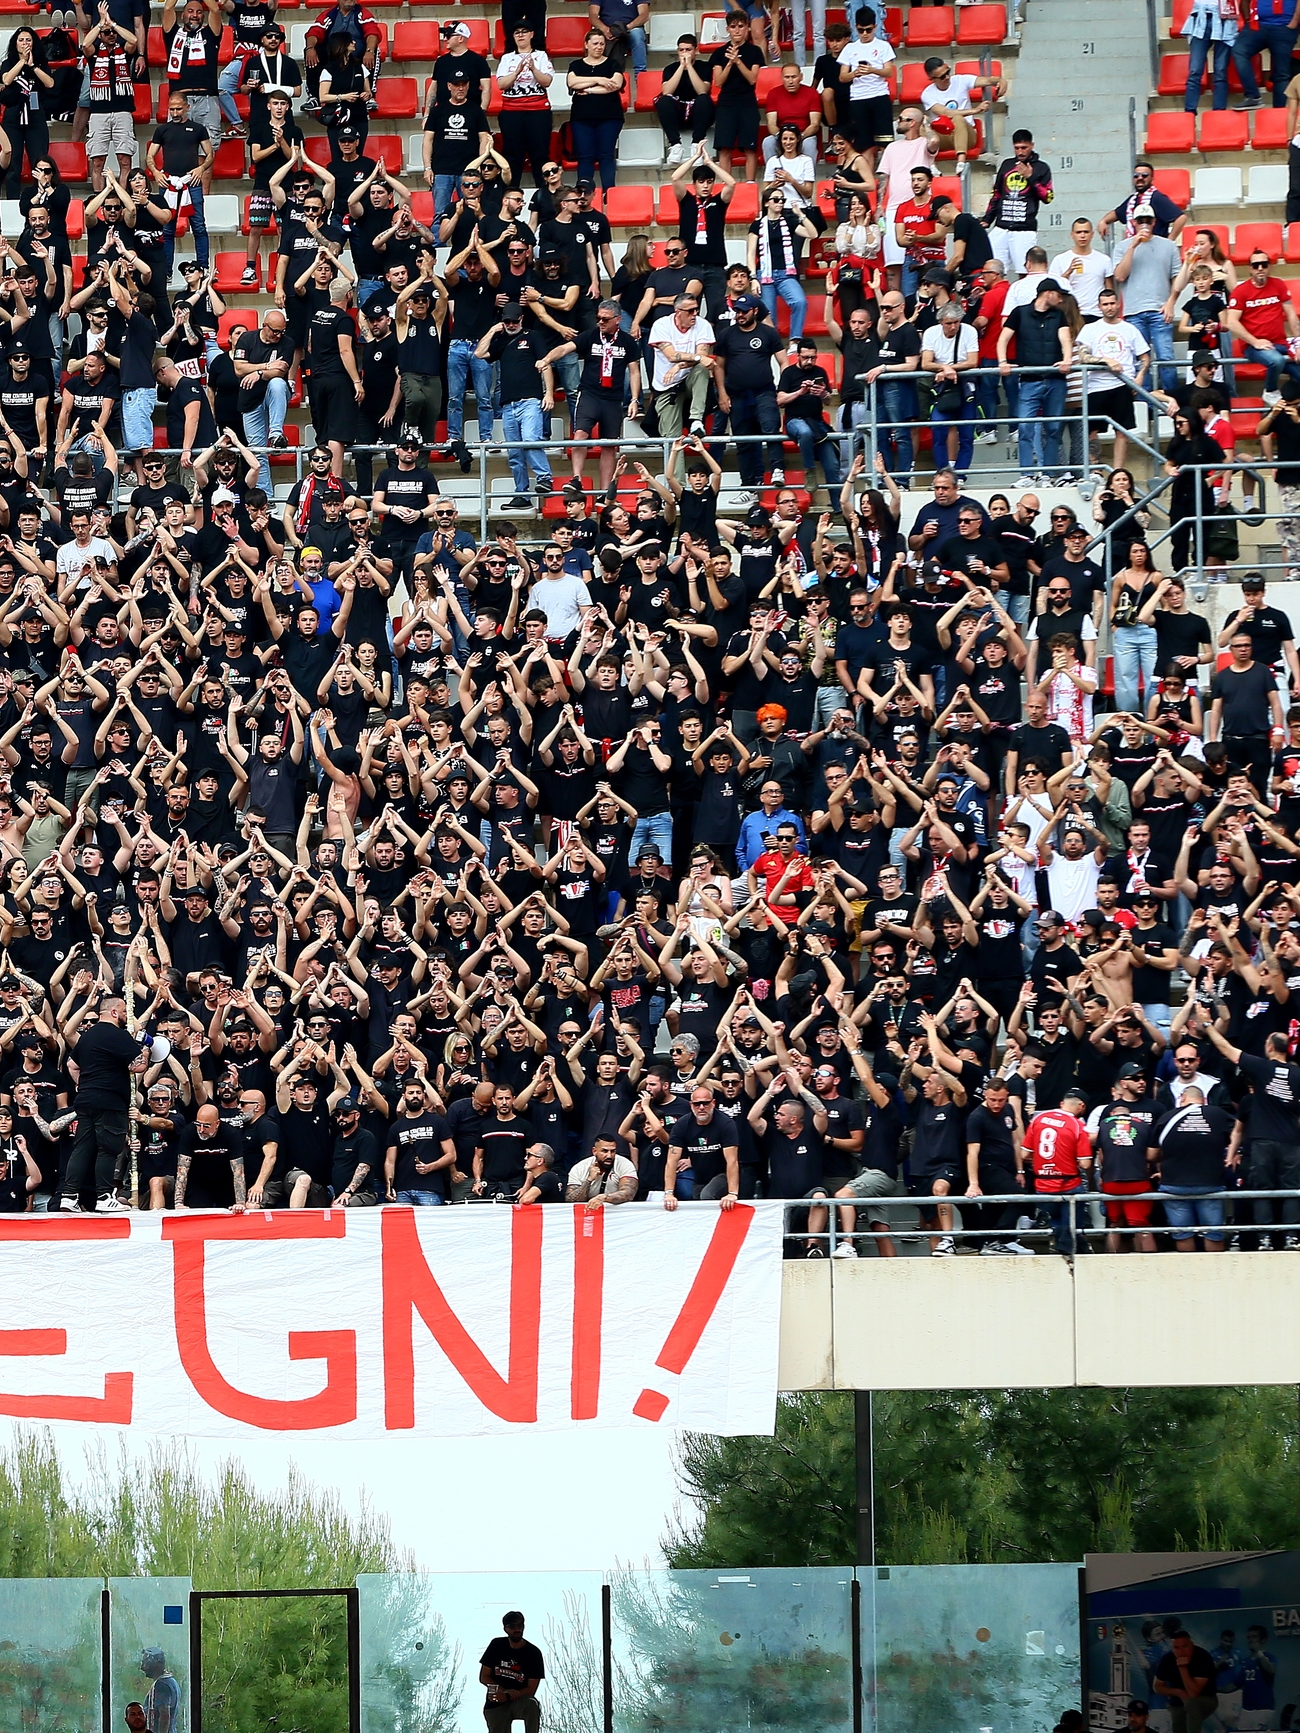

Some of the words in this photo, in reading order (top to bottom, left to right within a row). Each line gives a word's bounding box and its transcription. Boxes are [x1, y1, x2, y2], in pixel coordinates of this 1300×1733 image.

[1082, 43, 1095, 56] 21
[1071, 100, 1084, 111] 20
[1060, 157, 1073, 169] 19
[1048, 213, 1062, 227] 18
[1006, 447, 1019, 460] 14
[1038, 1127, 1058, 1160] 8
[1245, 1669, 1256, 1681] 22
